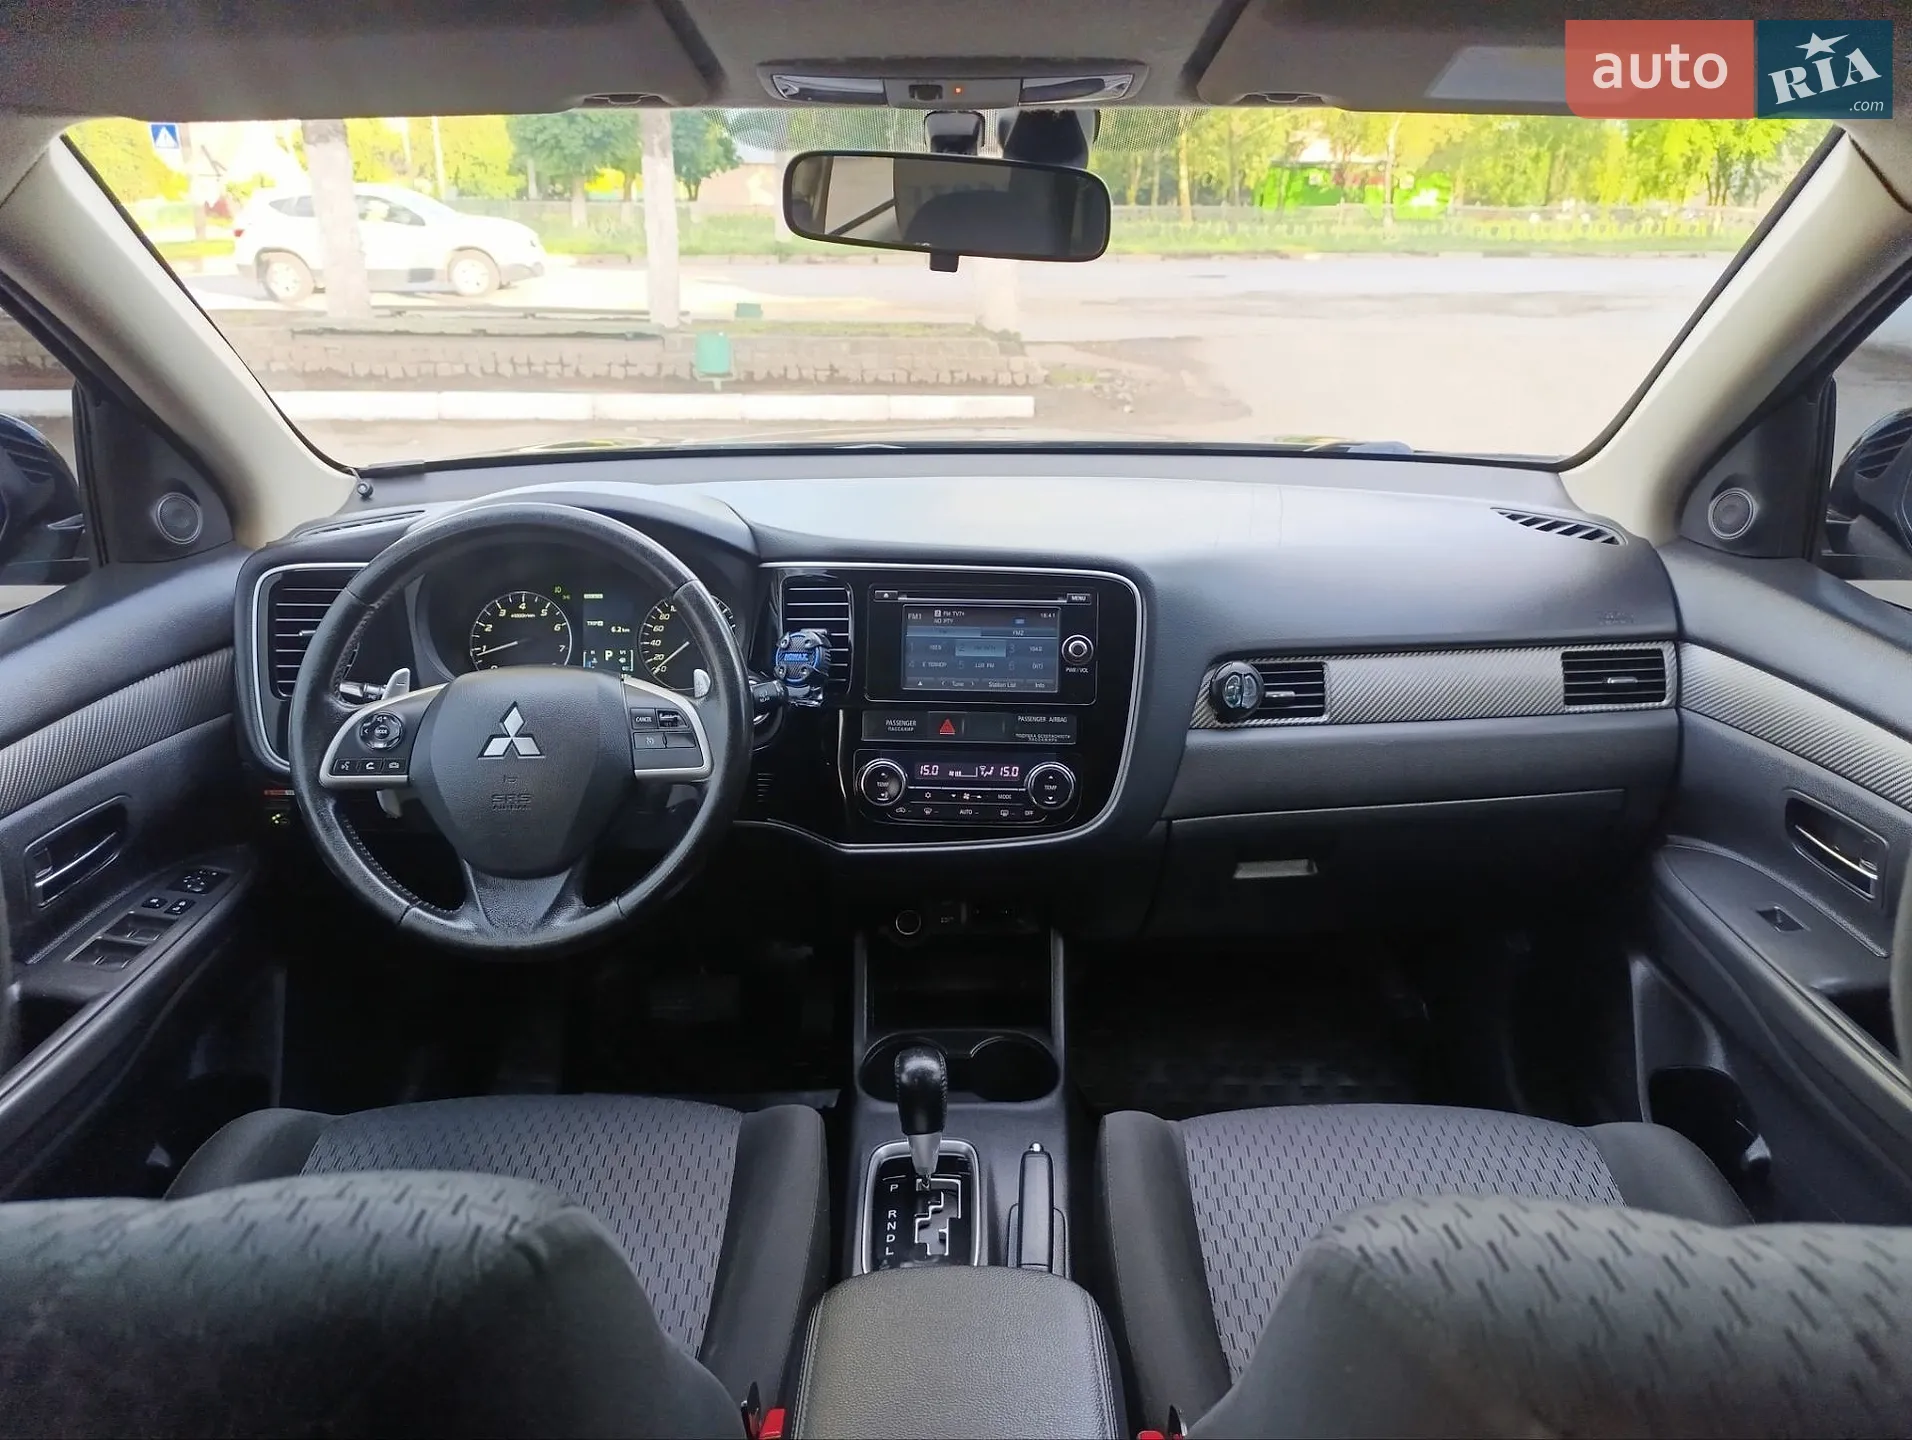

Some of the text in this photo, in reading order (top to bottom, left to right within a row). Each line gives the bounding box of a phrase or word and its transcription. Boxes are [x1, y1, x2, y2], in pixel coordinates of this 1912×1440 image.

[518, 602, 526, 610] 4
[498, 609, 506, 617] 3
[484, 624, 493, 632] 2
[605, 650, 613, 661] P
[920, 764, 939, 776] 15.0
[1000, 766, 1019, 777] 15.0
[890, 1184, 898, 1192] P
[888, 1210, 897, 1218] R
[887, 1222, 896, 1230] N
[886, 1247, 894, 1255] L
